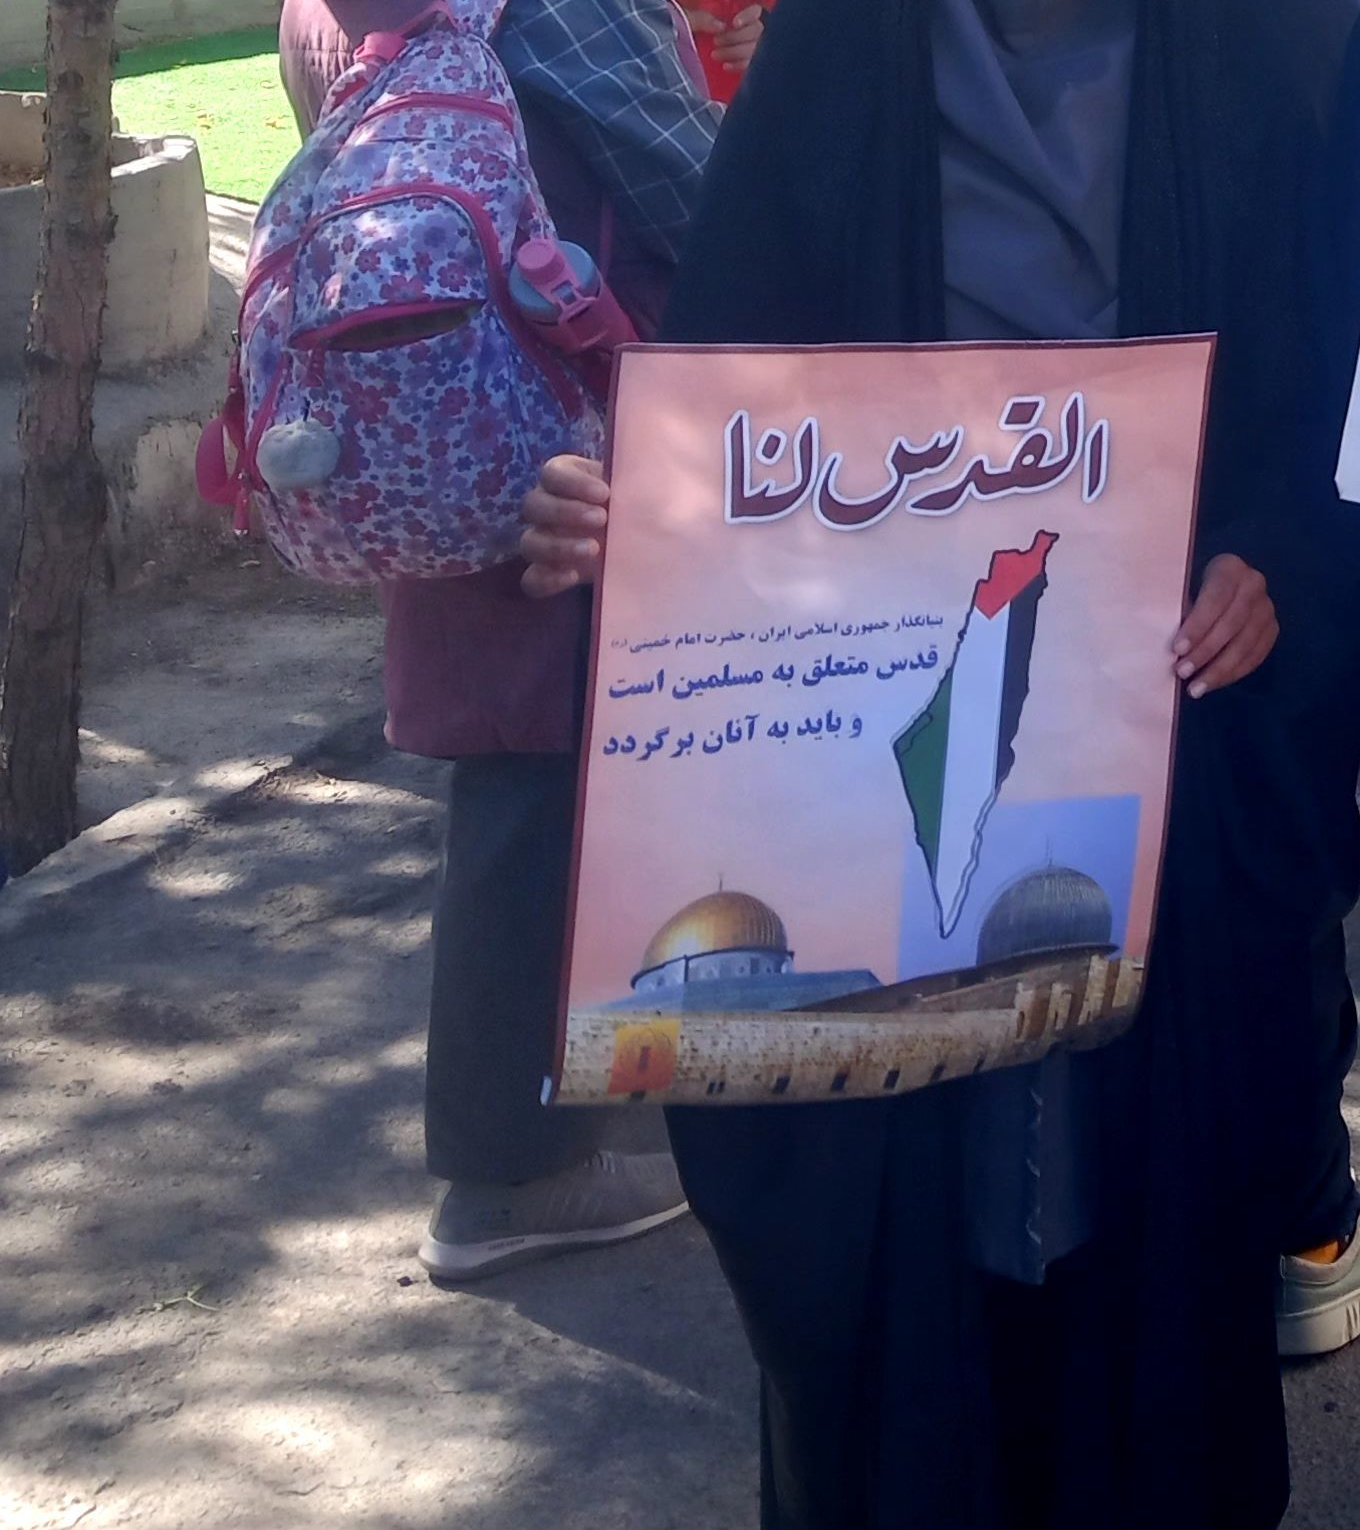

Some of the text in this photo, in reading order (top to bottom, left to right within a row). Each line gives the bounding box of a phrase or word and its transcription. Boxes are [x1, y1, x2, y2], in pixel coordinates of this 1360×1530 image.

[724, 392, 1110, 530] القدس لنا
[675, 633, 701, 648] امام
[704, 629, 746, 646] حضرت
[794, 622, 838, 641] اسلامی
[841, 620, 890, 637] جمهوری
[629, 636, 671, 653] خمینی
[608, 643, 938, 699] قدس متعلق به مسلمین است
[702, 714, 759, 754] آنان
[766, 720, 789, 745] به
[796, 709, 842, 741] باید
[849, 712, 863, 739] و
